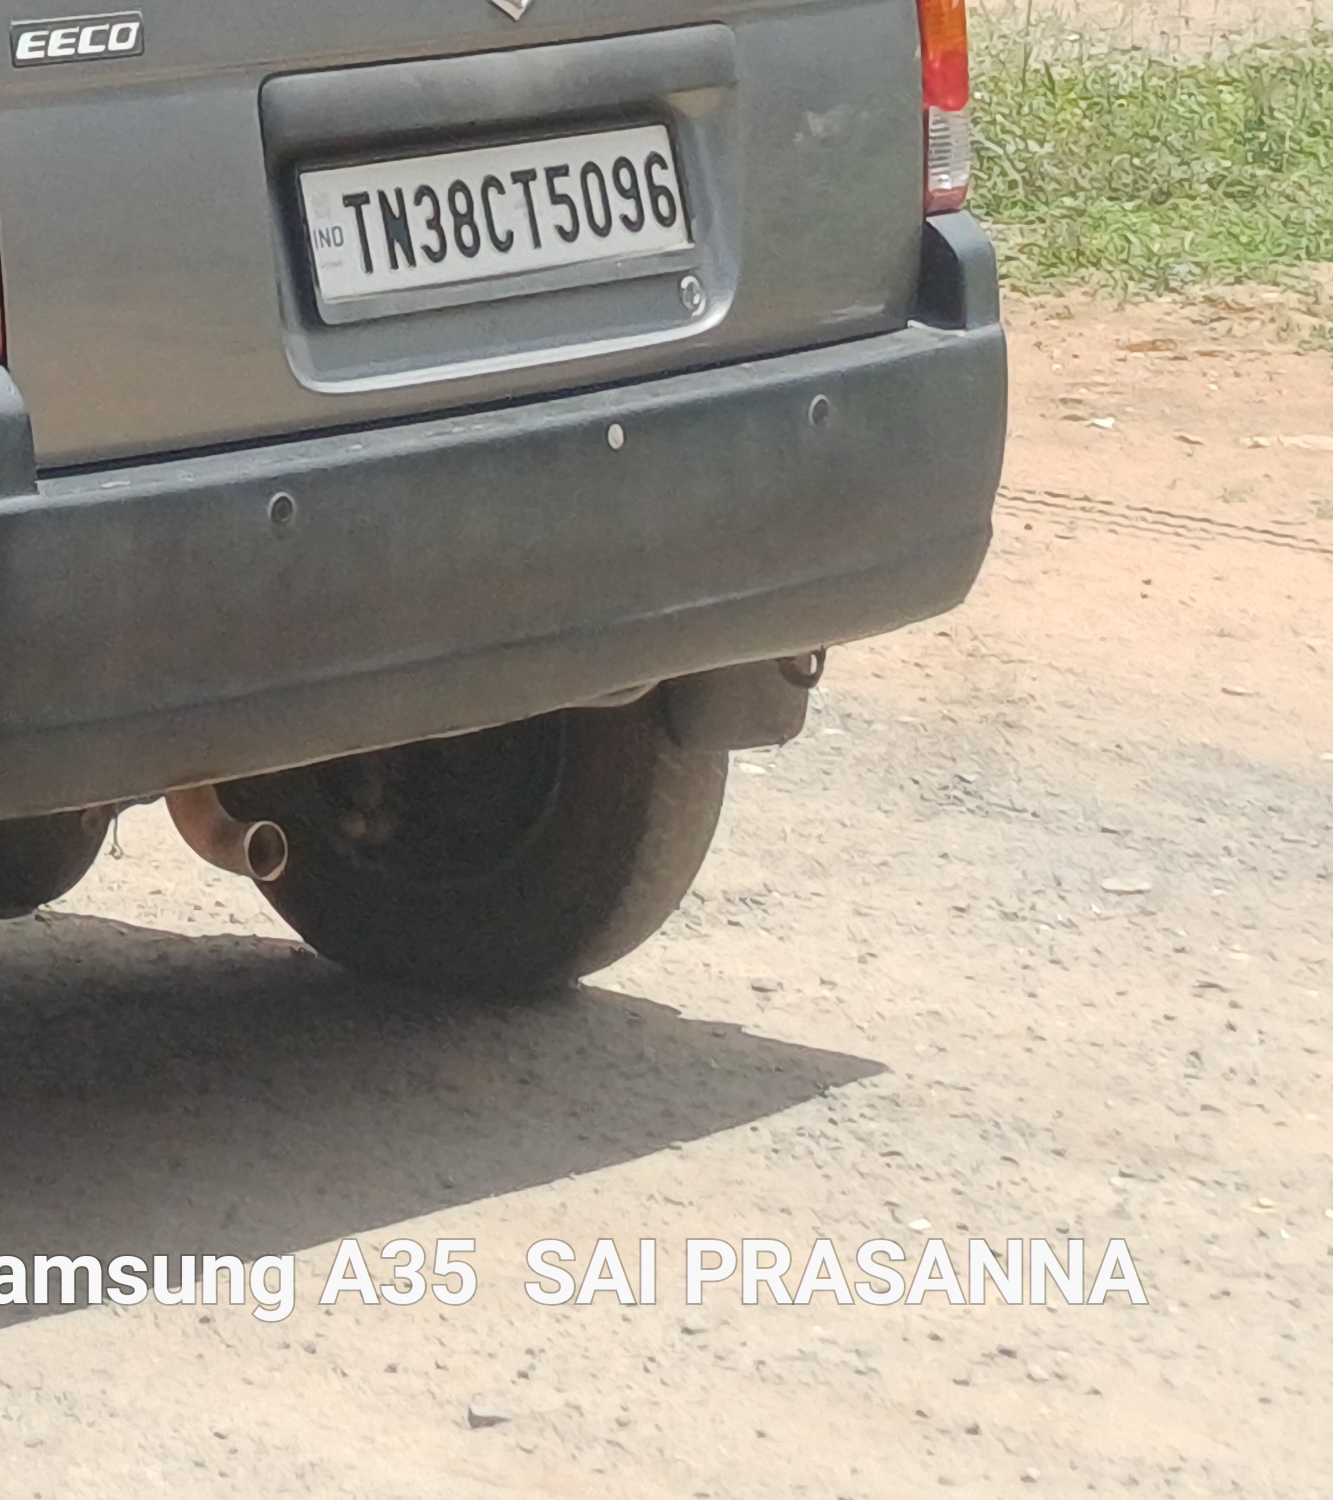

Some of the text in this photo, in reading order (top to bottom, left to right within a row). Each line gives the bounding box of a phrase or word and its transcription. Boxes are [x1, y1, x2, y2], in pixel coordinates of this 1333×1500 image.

[15, 21, 141, 61] EECO
[313, 150, 678, 275] IND TN38CT5096
